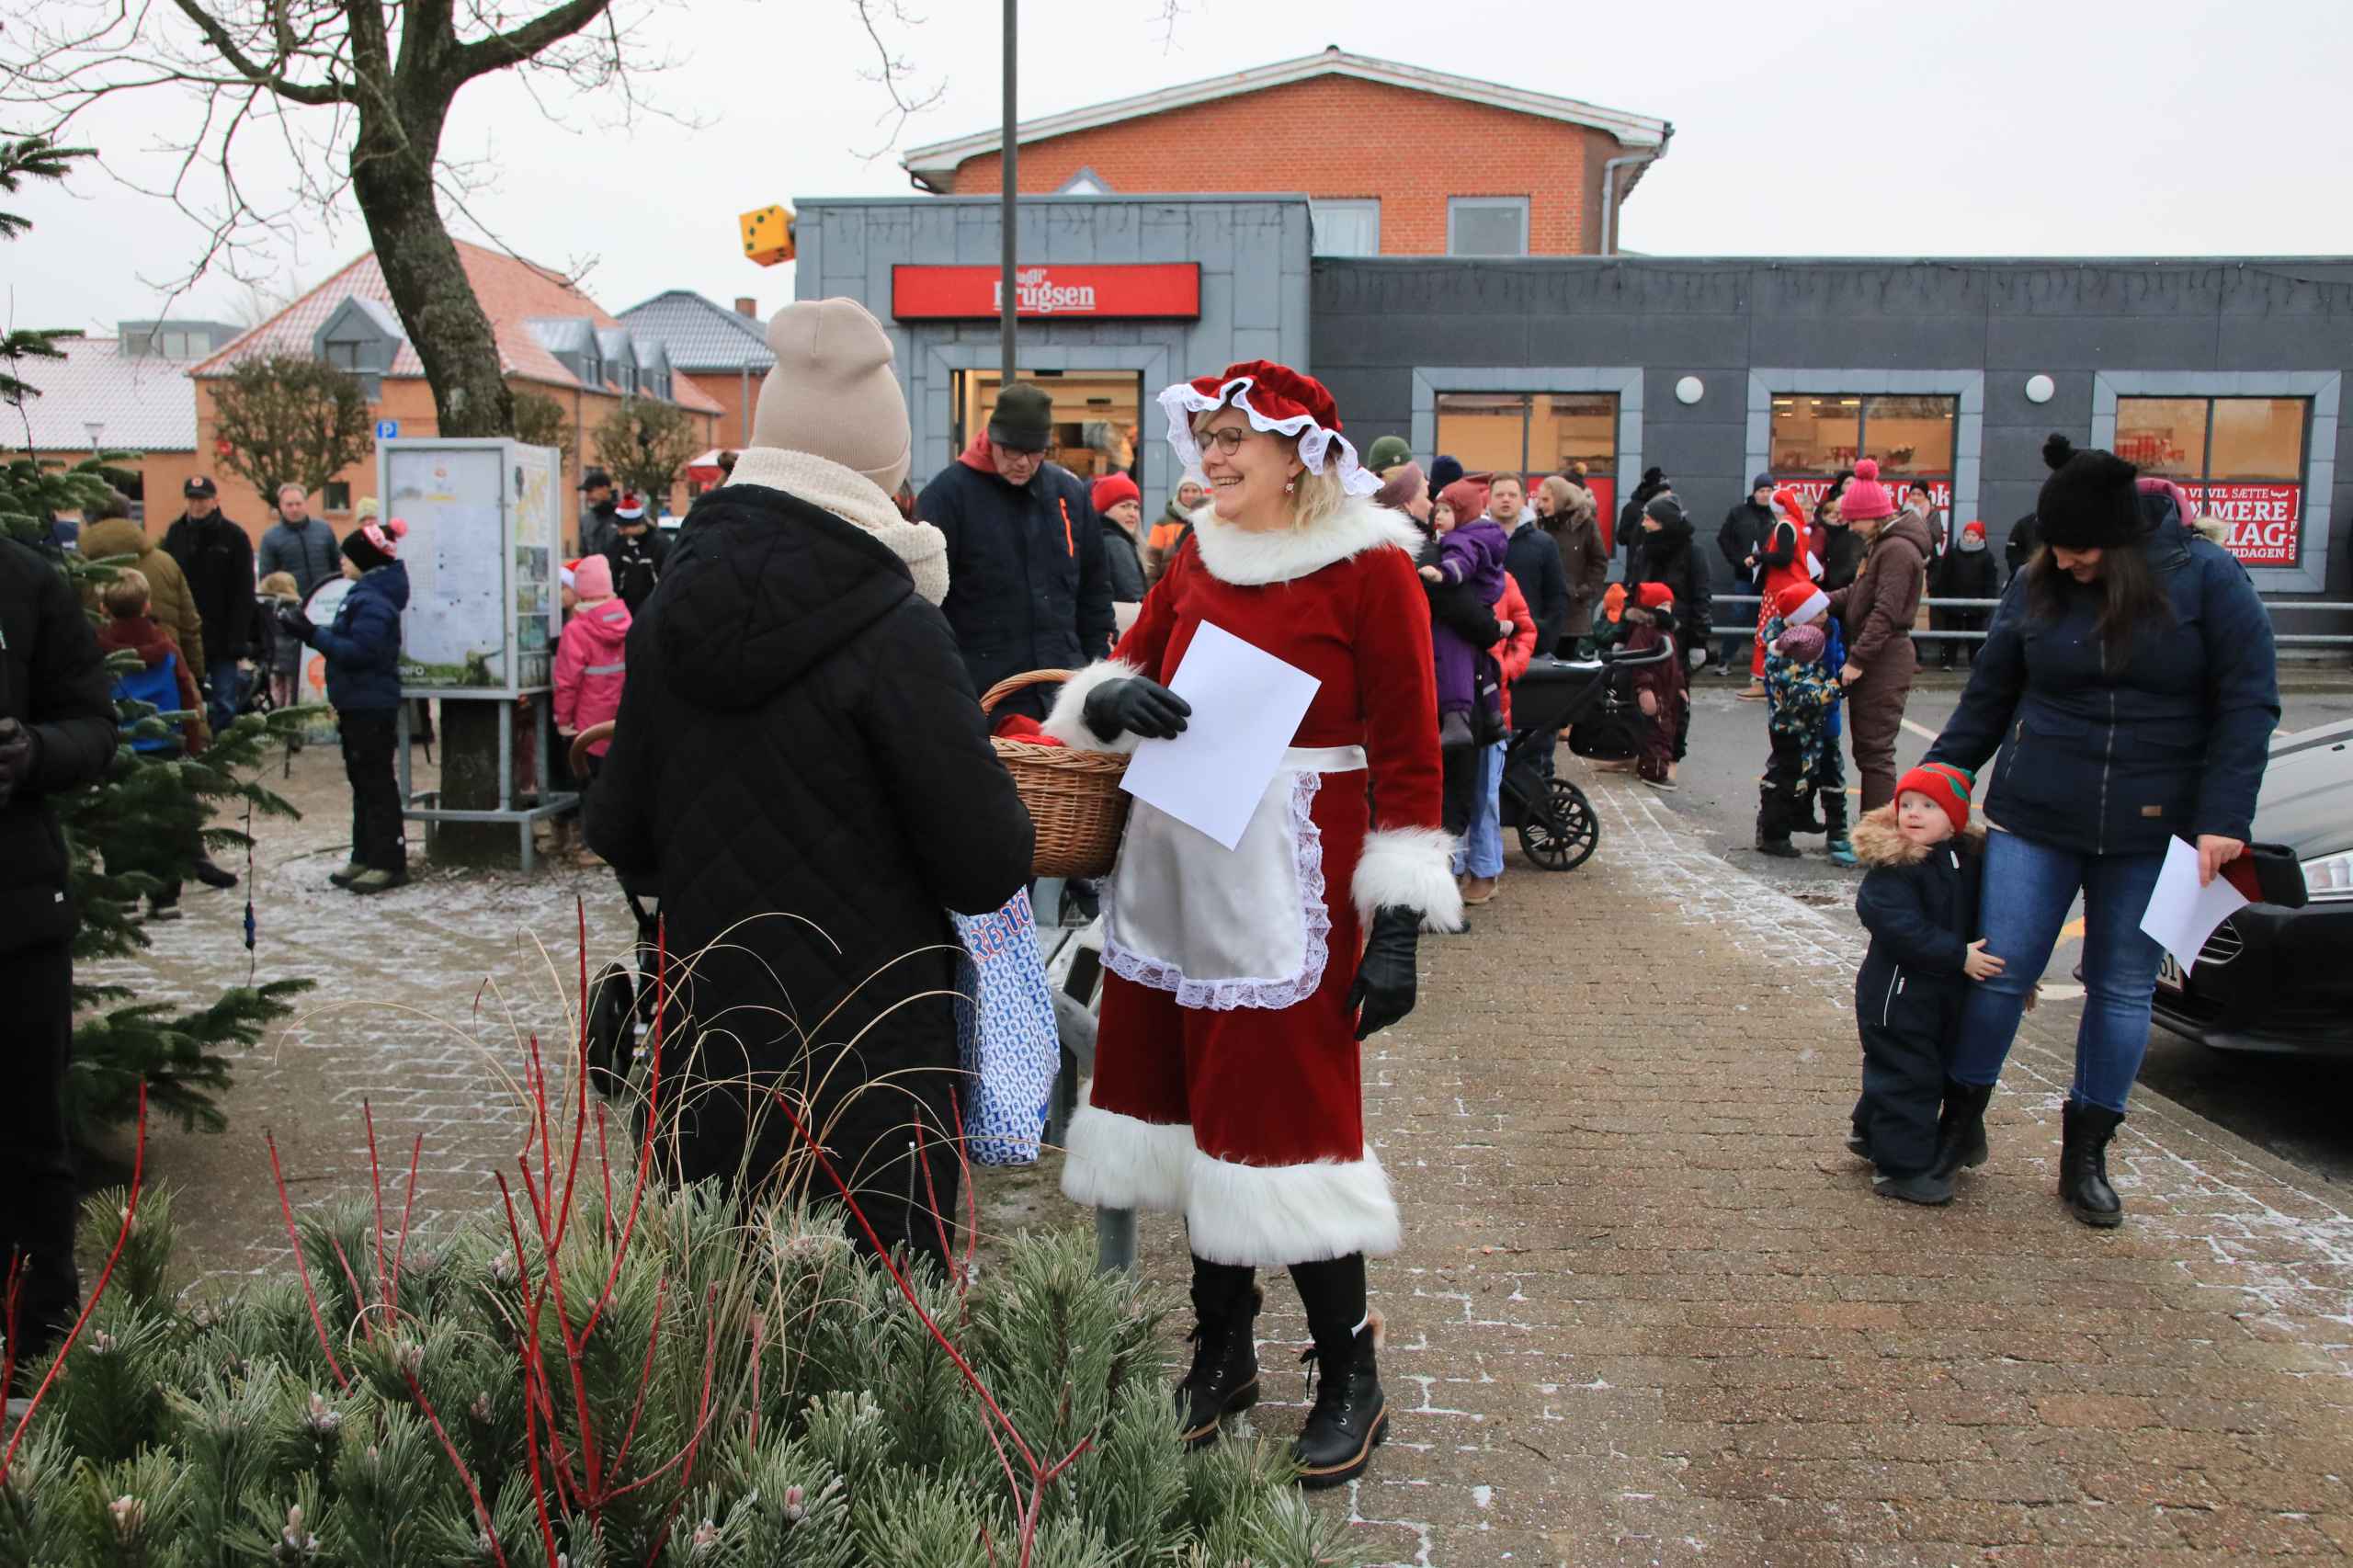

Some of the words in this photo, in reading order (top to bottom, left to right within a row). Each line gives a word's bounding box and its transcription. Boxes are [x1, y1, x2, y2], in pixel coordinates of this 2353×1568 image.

[2208, 488, 2228, 498] VIL
[2232, 488, 2268, 499] SÆTTE
[2209, 501, 2288, 521] MERE
